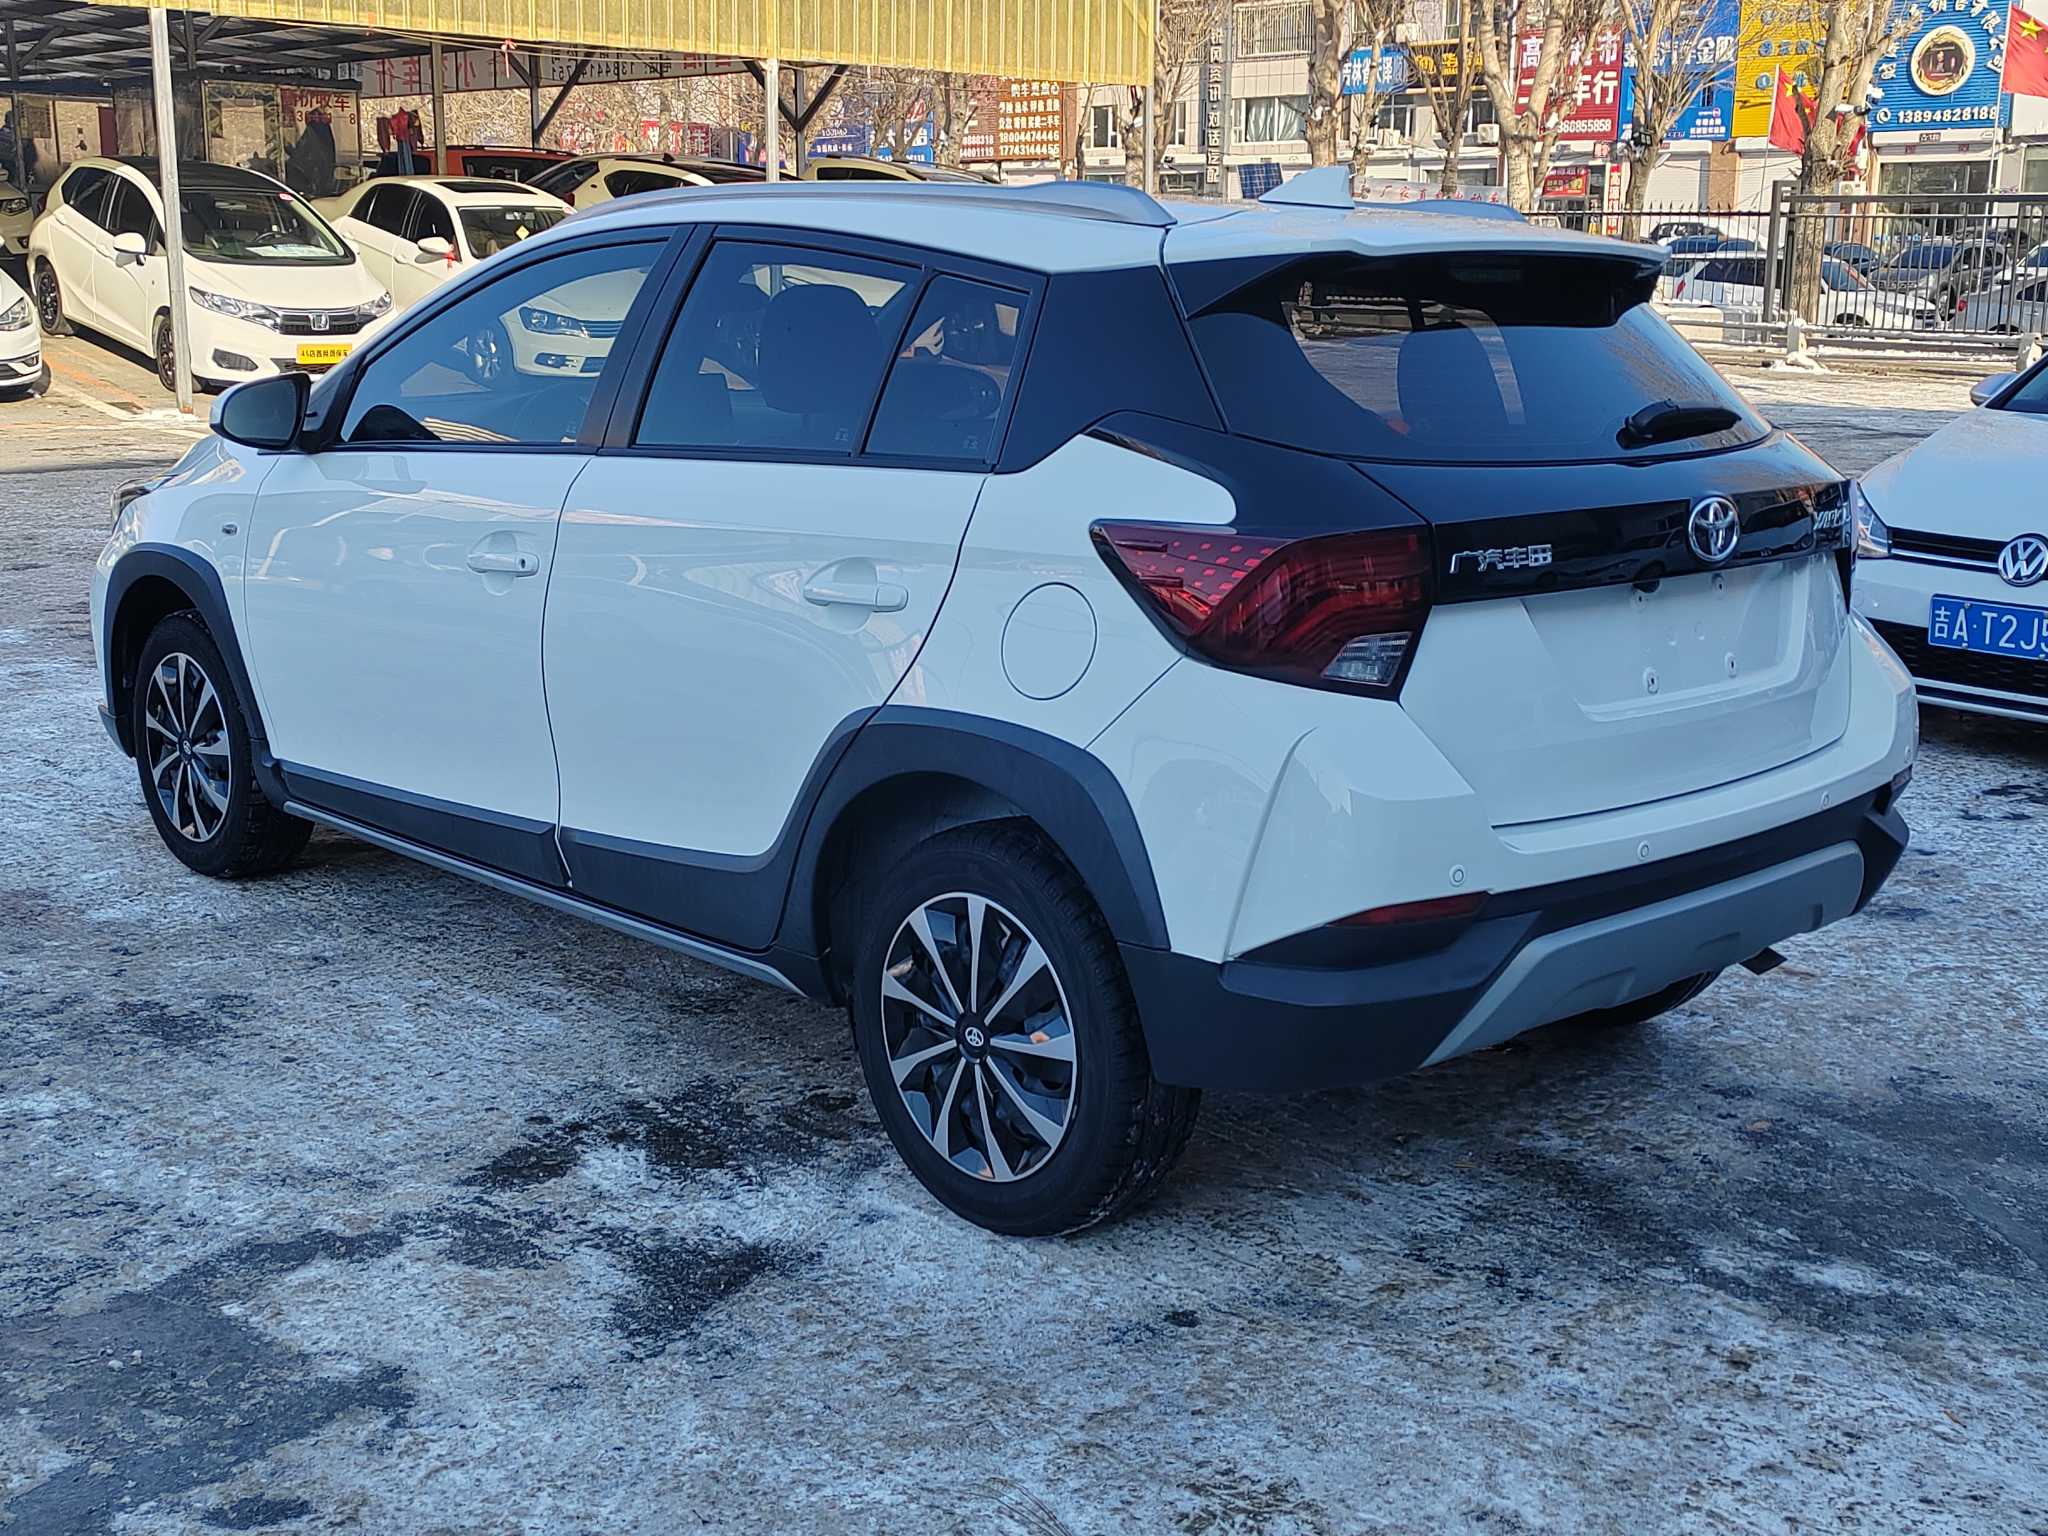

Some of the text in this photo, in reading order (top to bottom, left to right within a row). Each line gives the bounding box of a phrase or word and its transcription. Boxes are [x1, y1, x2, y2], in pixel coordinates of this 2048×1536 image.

[1897, 106, 1997, 123] 13894828188
[1449, 544, 1552, 575] 广汽丰田
